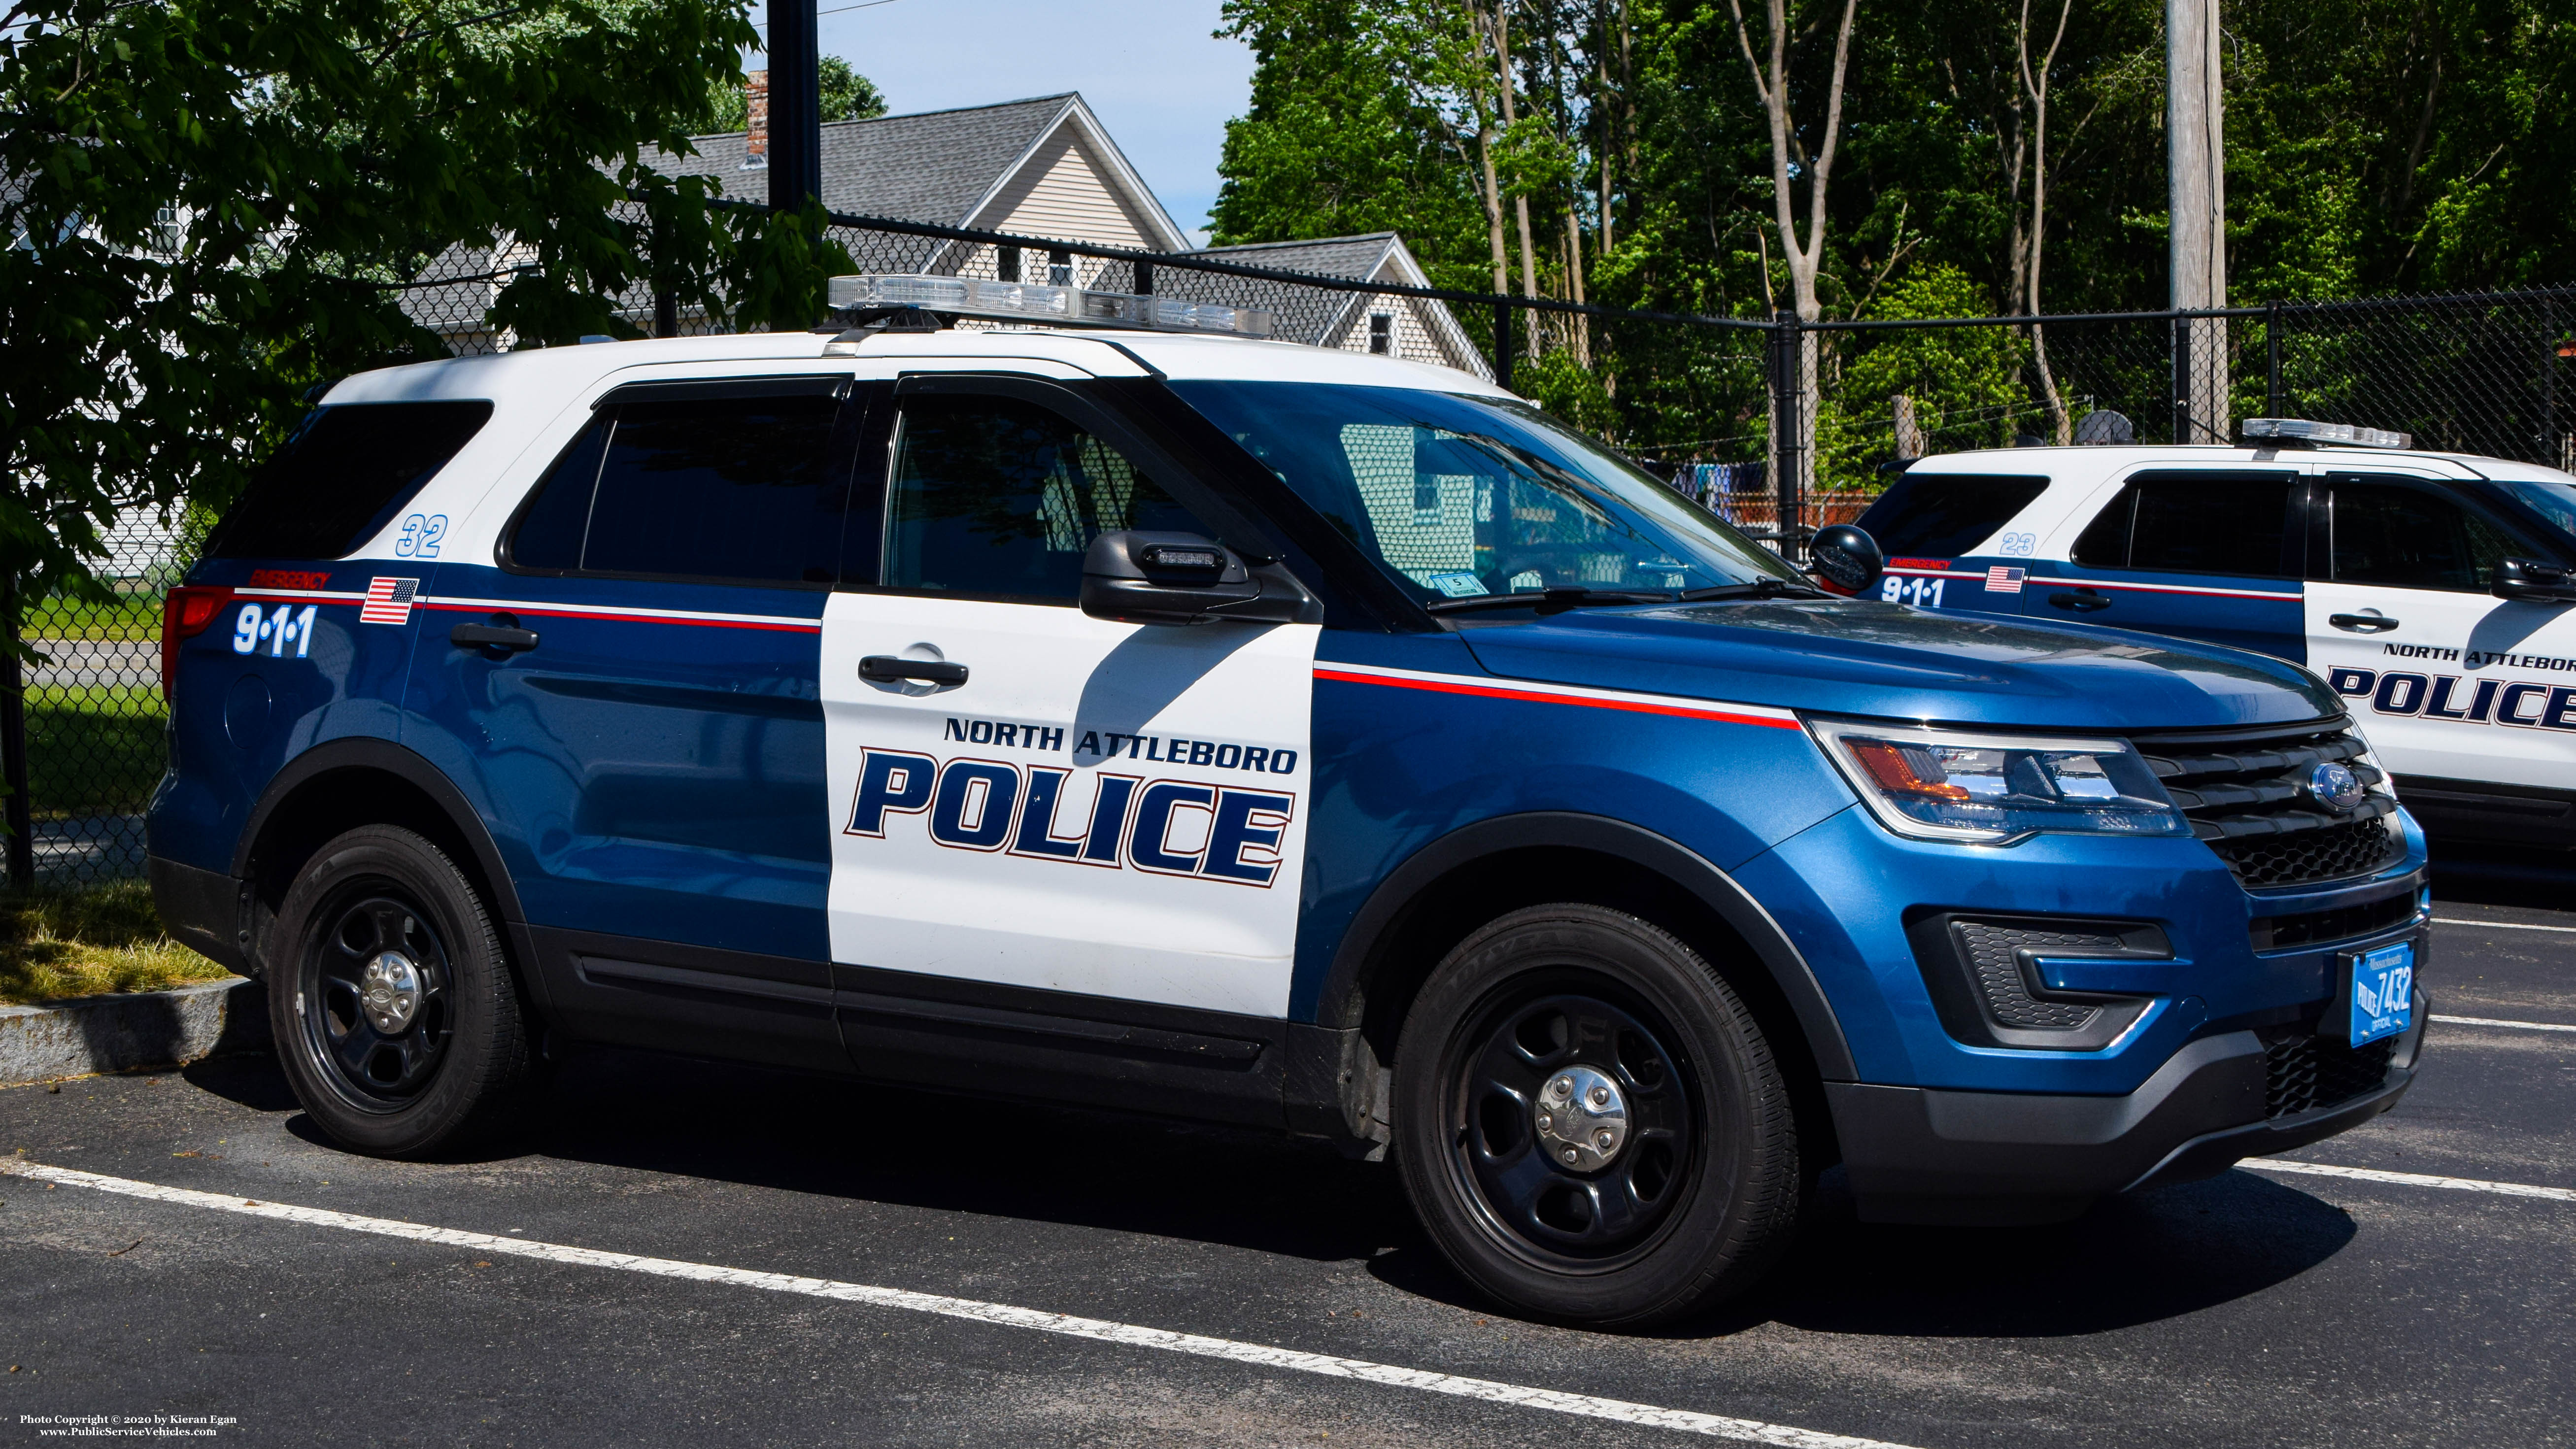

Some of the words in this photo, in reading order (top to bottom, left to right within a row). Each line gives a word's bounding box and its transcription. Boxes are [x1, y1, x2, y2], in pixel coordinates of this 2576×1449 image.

[395, 513, 448, 558] 32
[1999, 532, 2036, 556] 23
[250, 569, 332, 589] EMERGENCY
[1890, 558, 1951, 570] EMERGENCY
[2383, 643, 2459, 662] NORTH
[2325, 665, 2576, 734] POLICE
[944, 717, 1064, 752] NORTH
[1073, 731, 1298, 775] ATTLEBORO
[842, 745, 1296, 889] POLICE
[2358, 981, 2377, 1017] POLICE
[2378, 966, 2411, 1017] 7432
